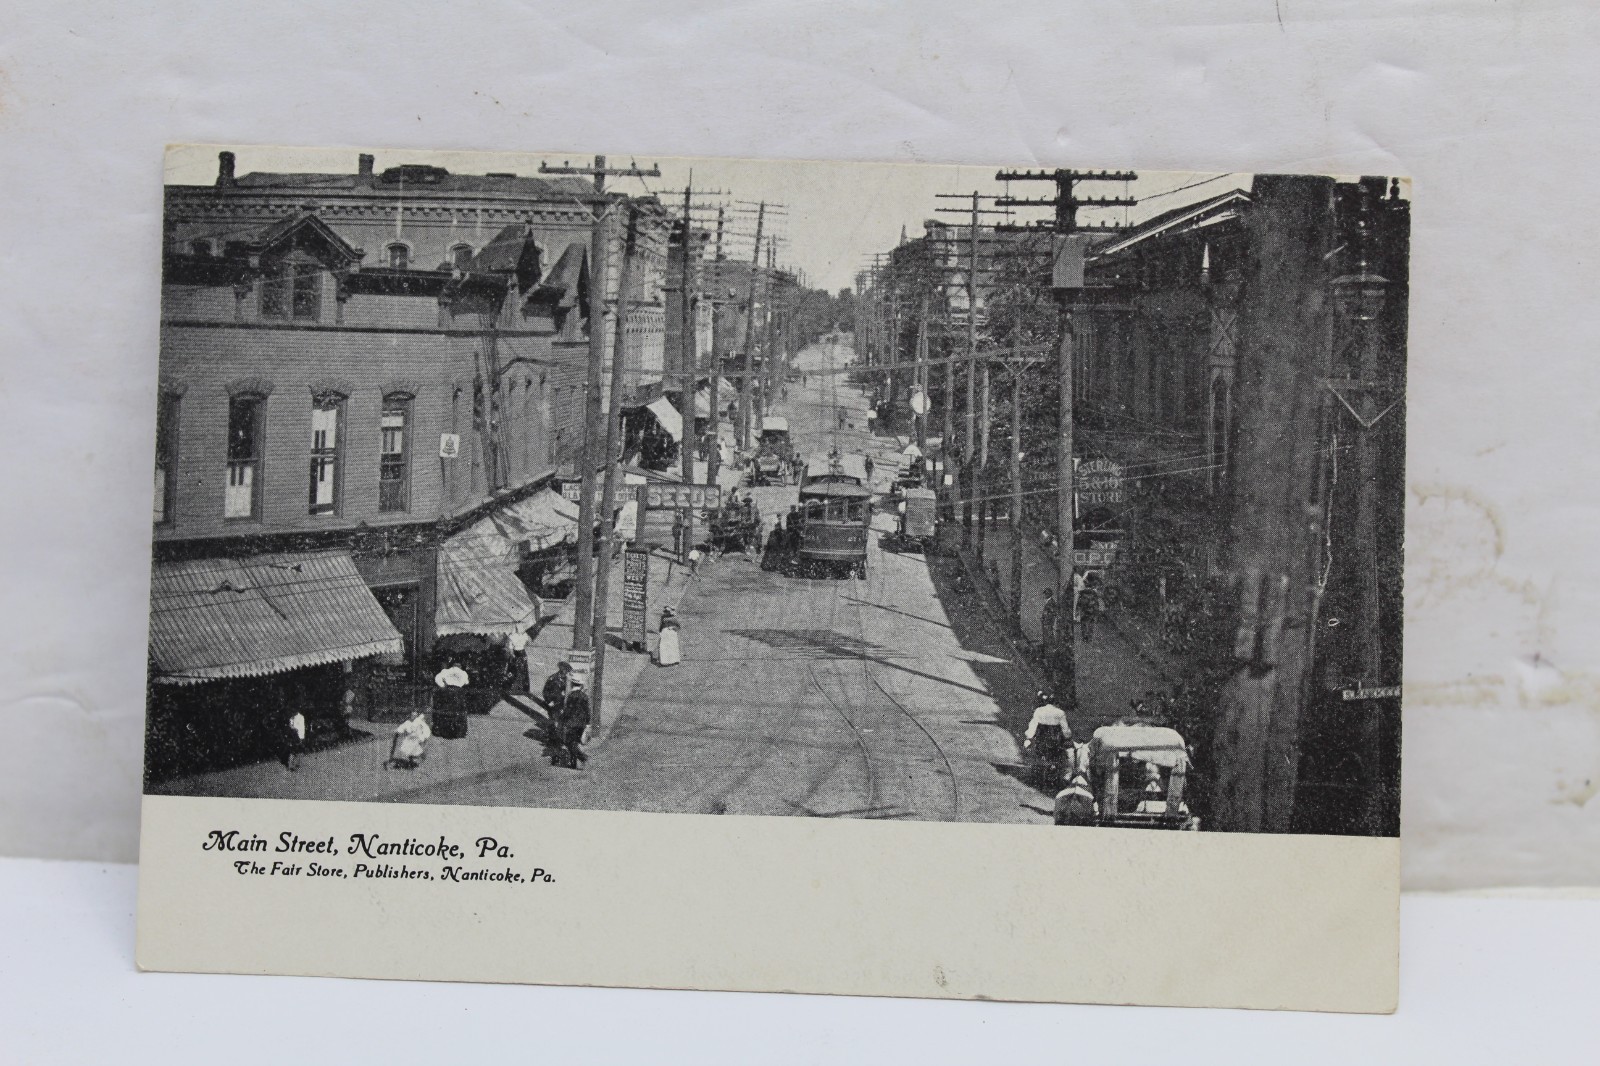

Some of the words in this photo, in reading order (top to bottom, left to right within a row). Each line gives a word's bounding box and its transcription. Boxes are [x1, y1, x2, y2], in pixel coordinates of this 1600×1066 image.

[646, 484, 721, 508] SEEDS
[202, 830, 268, 852] Main
[274, 831, 339, 857] Street,
[347, 833, 465, 861] Nanticoke,
[475, 836, 515, 859] Pa.
[233, 860, 266, 876] The
[270, 861, 303, 876] Fair
[306, 862, 348, 880] Store,
[352, 863, 435, 882] Publishers,
[440, 865, 526, 884] Nanticoke,
[530, 867, 556, 883] Pa.
